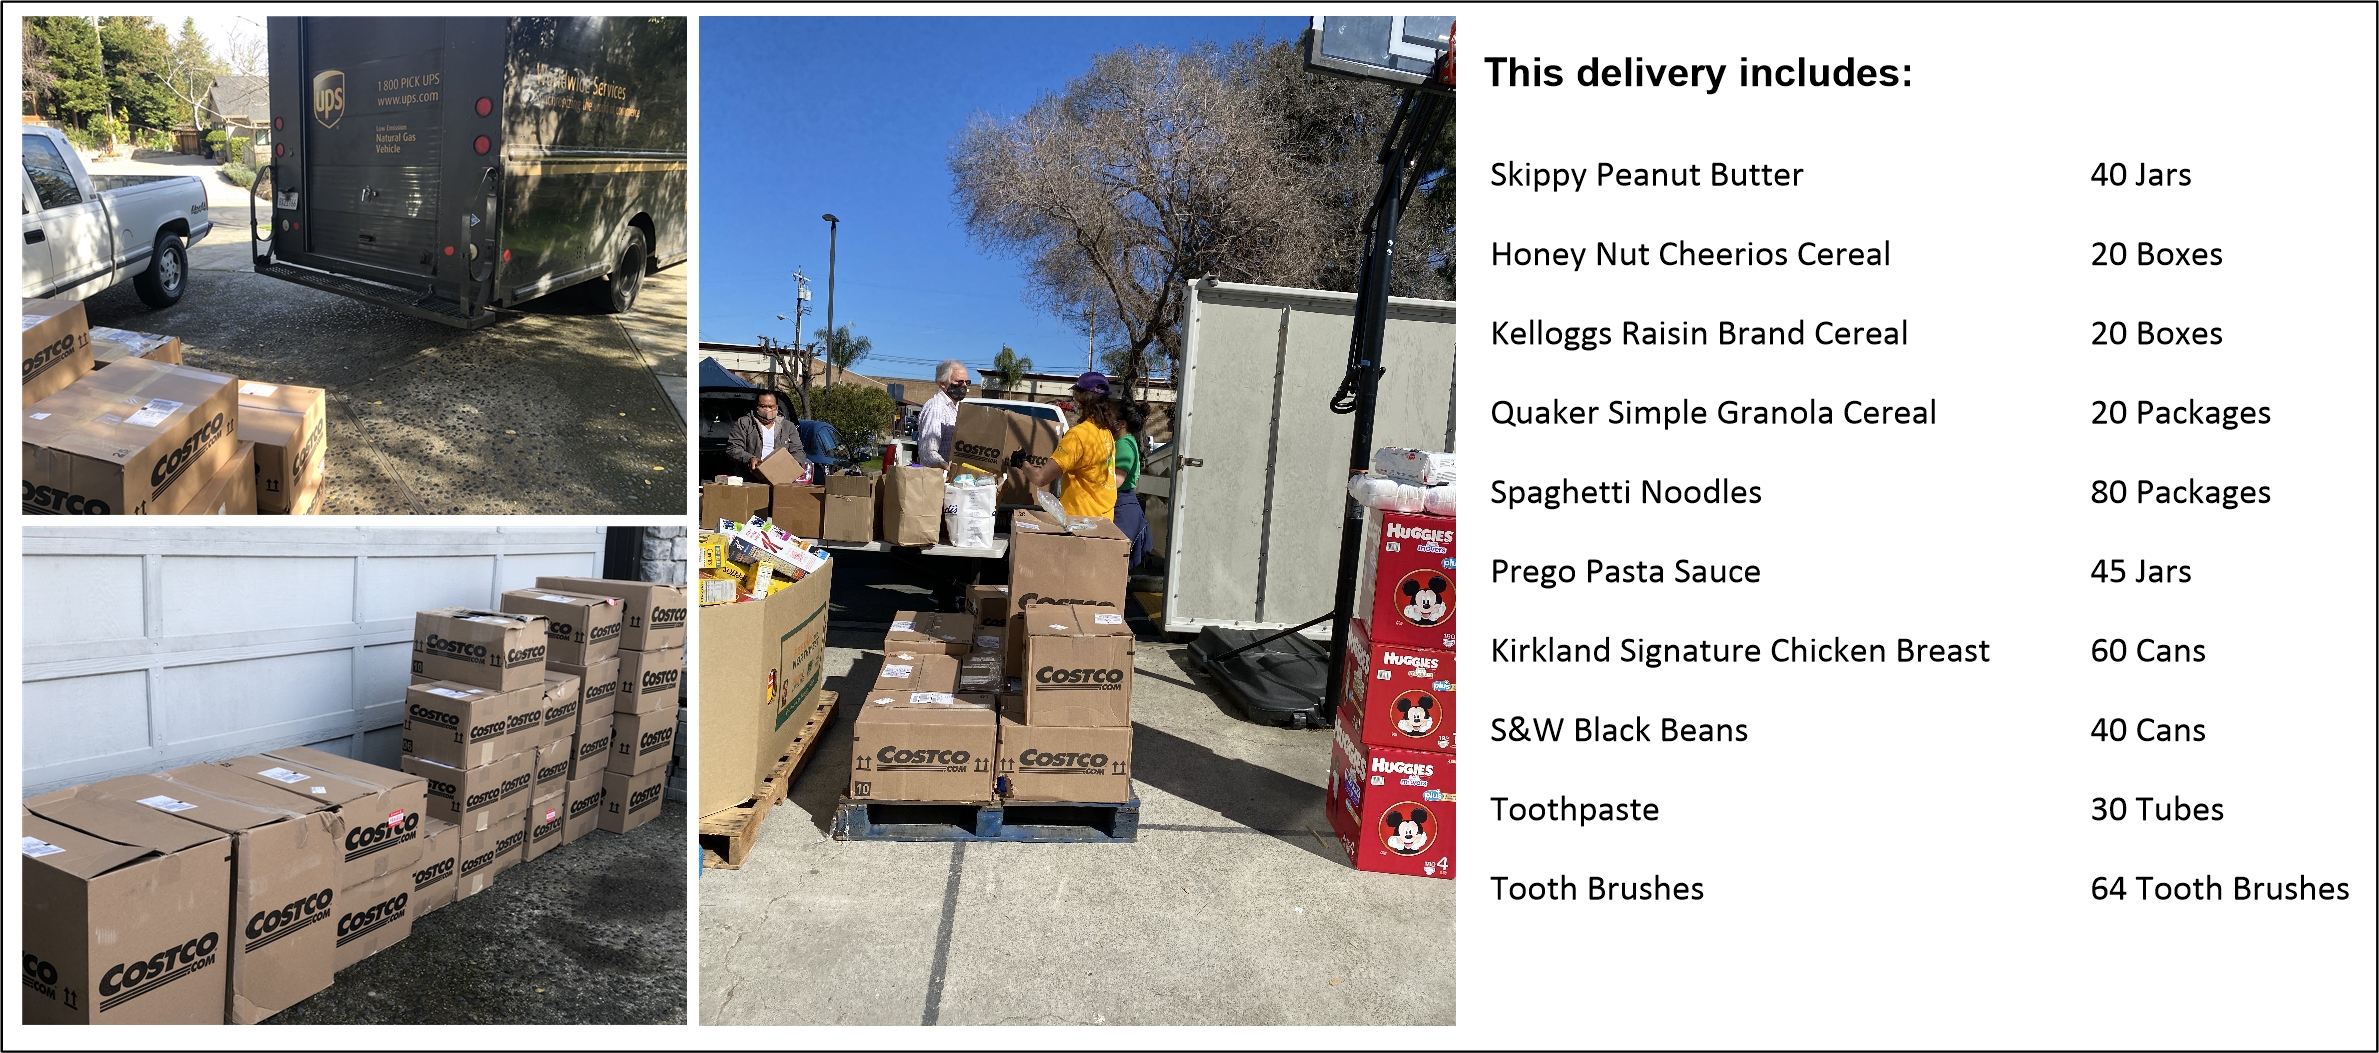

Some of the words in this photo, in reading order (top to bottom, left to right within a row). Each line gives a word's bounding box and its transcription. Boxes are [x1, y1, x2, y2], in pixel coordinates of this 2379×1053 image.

[383, 79, 399, 91] 800
[401, 76, 421, 89] PICK
[422, 73, 440, 86] UPS
[593, 76, 627, 101] Services
[316, 87, 343, 119] ups
[377, 91, 439, 107] www.ups.com
[376, 133, 401, 143] Natural
[403, 132, 416, 142] Gas
[375, 144, 401, 154] Vehicle
[22, 333, 75, 377] OSTCO
[151, 412, 224, 487] COSTCO
[292, 417, 324, 477] COSTCO
[954, 440, 1001, 459] COSTCO
[22, 478, 111, 515] OSTCO
[1387, 522, 1454, 544] HUGGIES
[650, 606, 688, 623] COSTCO
[590, 622, 621, 639] COSTCO
[426, 634, 488, 658] COSTCO
[507, 645, 546, 662] COSTCO
[413, 661, 423, 672] 10
[1384, 651, 1439, 669] HUGGIES
[642, 669, 678, 687] COSTCO
[1035, 666, 1124, 684] COSTCO
[586, 681, 617, 698] COSTCO
[409, 704, 460, 725] COSTCO
[545, 701, 577, 720] COSTCO
[470, 720, 506, 739] COSTCO
[640, 727, 673, 748] COSTCO
[580, 737, 609, 755] COSTCO
[876, 745, 971, 764] COSTCO
[1019, 748, 1109, 767] COSTCO
[1371, 757, 1434, 777] HUGGIES
[537, 760, 568, 780] COSTCO
[428, 778, 456, 794] STCO
[630, 783, 662, 807] COSTCO
[856, 783, 870, 795] 10
[467, 788, 500, 807] COSTCO
[570, 792, 600, 813] COSTCO
[412, 857, 455, 884] OSTCO
[461, 851, 494, 872] COSTCO
[1437, 856, 1449, 870] 4
[244, 888, 334, 940] COSTCO
[337, 892, 408, 937] COSTCO
[98, 931, 220, 997] COSTCO
[187, 953, 216, 975] .COM
